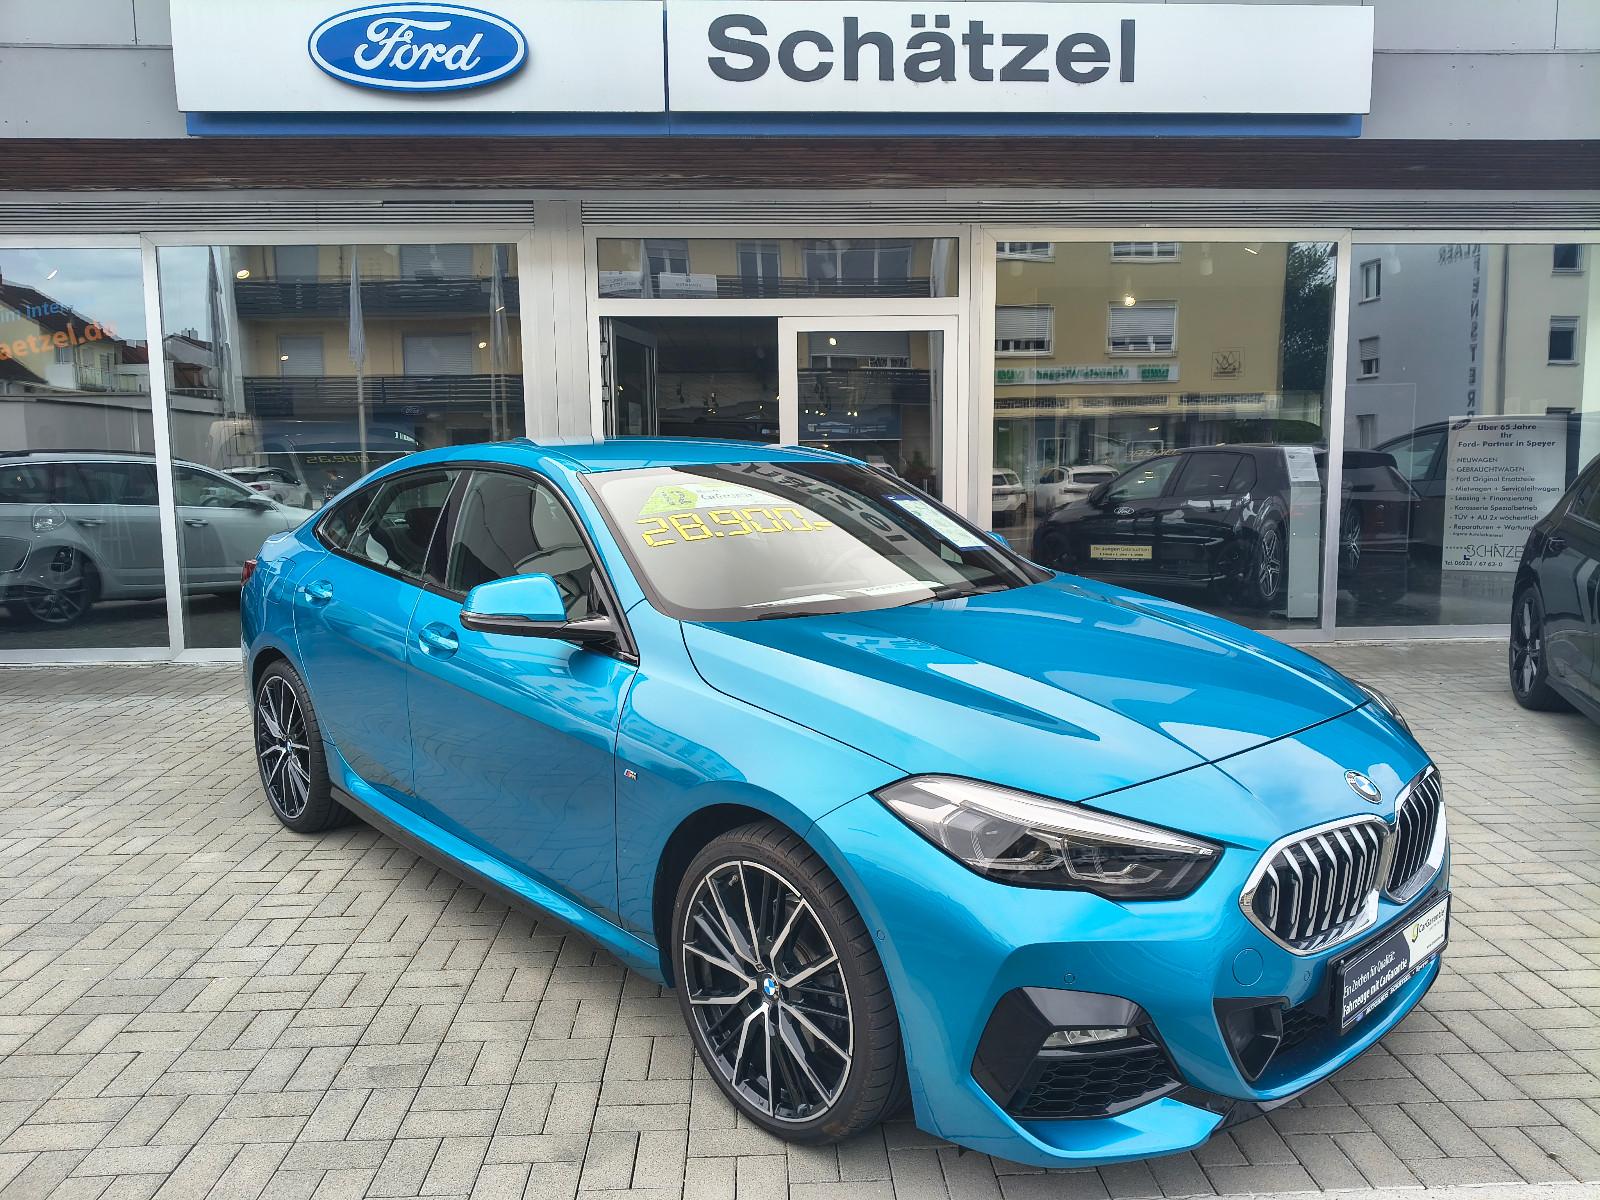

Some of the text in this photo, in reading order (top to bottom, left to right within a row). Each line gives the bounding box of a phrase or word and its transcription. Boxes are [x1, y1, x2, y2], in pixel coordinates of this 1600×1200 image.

[353, 17, 484, 71] Ford
[707, 14, 1136, 84] Schätzel
[1500, 431, 1513, 439] Ihr
[1516, 439, 1524, 447] in
[1526, 439, 1556, 448] Speyer
[1466, 543, 1525, 558] SCHÄTZE
[1343, 988, 1371, 1016] Fahrzeuge
[1379, 957, 1408, 988] CarGarantie
